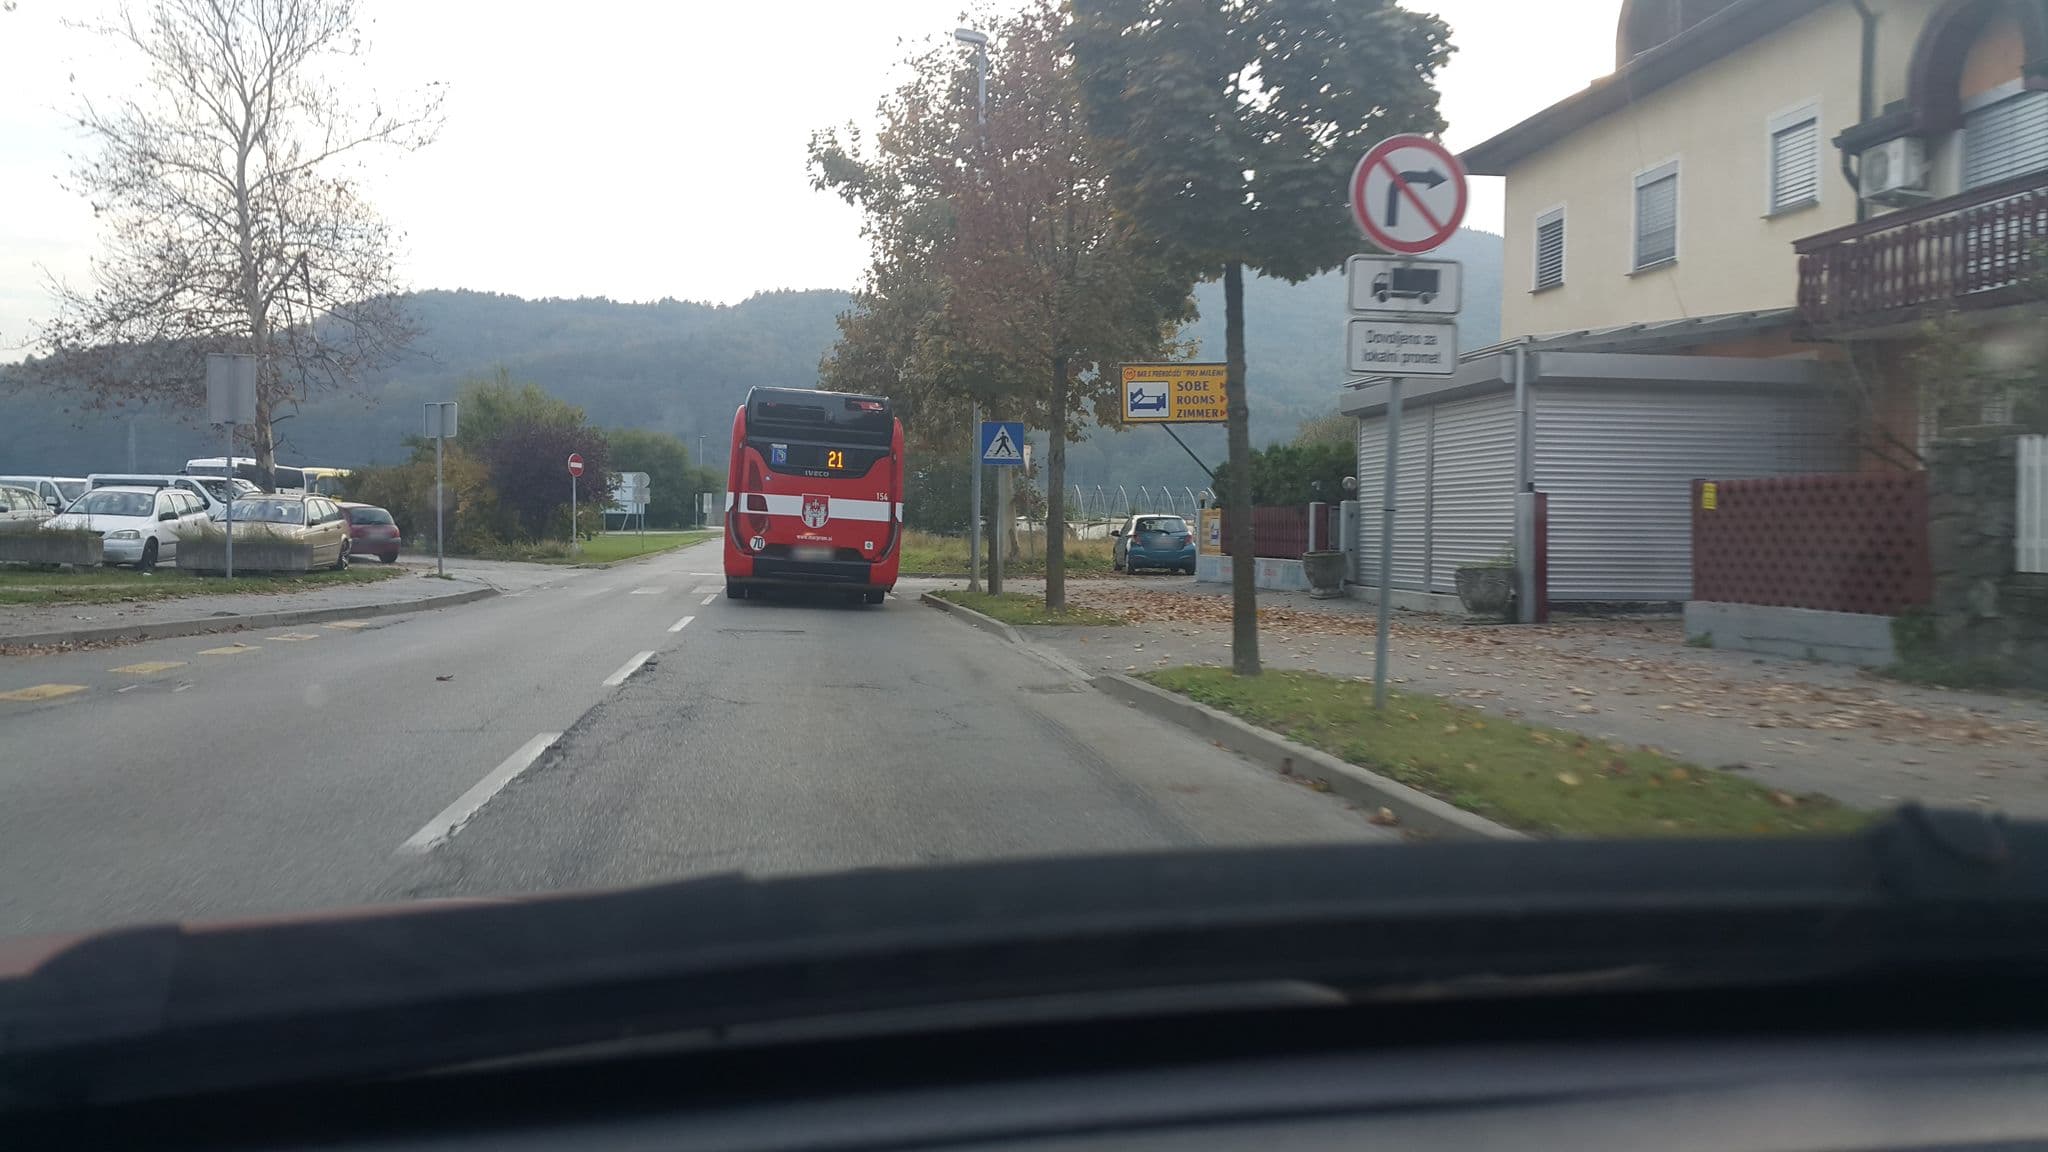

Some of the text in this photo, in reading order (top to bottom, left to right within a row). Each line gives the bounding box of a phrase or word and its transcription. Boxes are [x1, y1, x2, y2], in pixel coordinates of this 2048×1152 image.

[1365, 329, 1438, 347] Dovoljeno za
[1362, 347, 1442, 366] lokalni promet
[1176, 380, 1210, 392] SOBE
[1176, 394, 1216, 405] ROOMS
[1176, 408, 1219, 418] ZIMMER
[827, 450, 844, 469] 21
[805, 470, 830, 478] IVECO
[752, 536, 764, 549] 70
